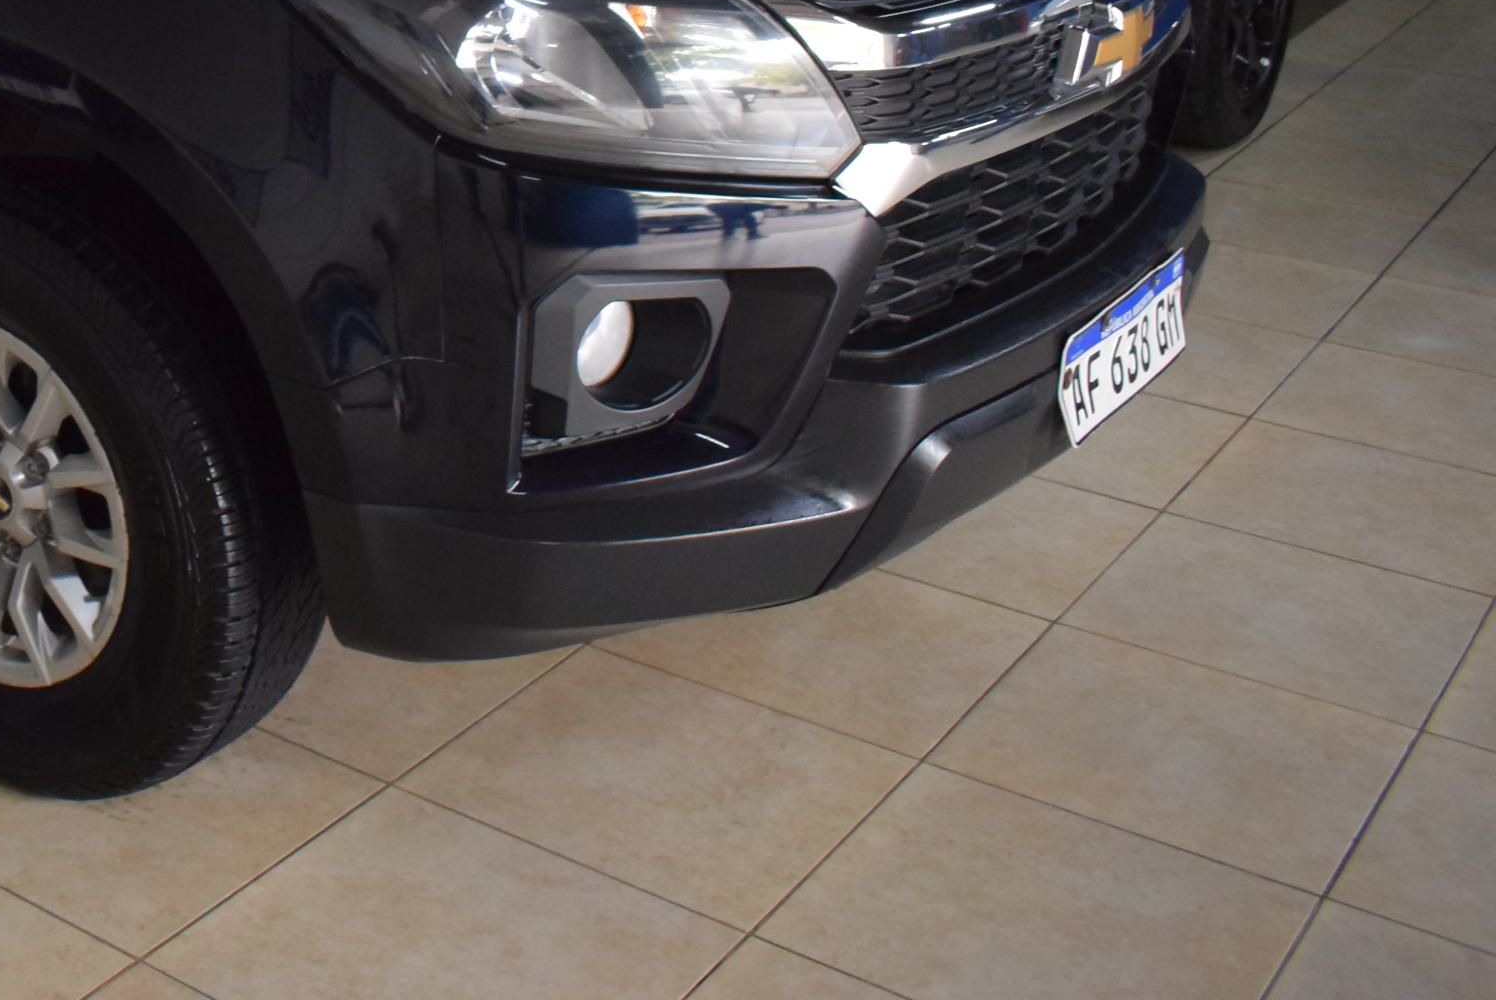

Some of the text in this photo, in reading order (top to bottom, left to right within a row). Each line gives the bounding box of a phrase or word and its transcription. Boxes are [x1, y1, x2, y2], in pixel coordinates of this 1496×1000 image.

[1072, 350, 1101, 426] AF
[1110, 314, 1151, 394] 638
[1156, 293, 1181, 356] GM
